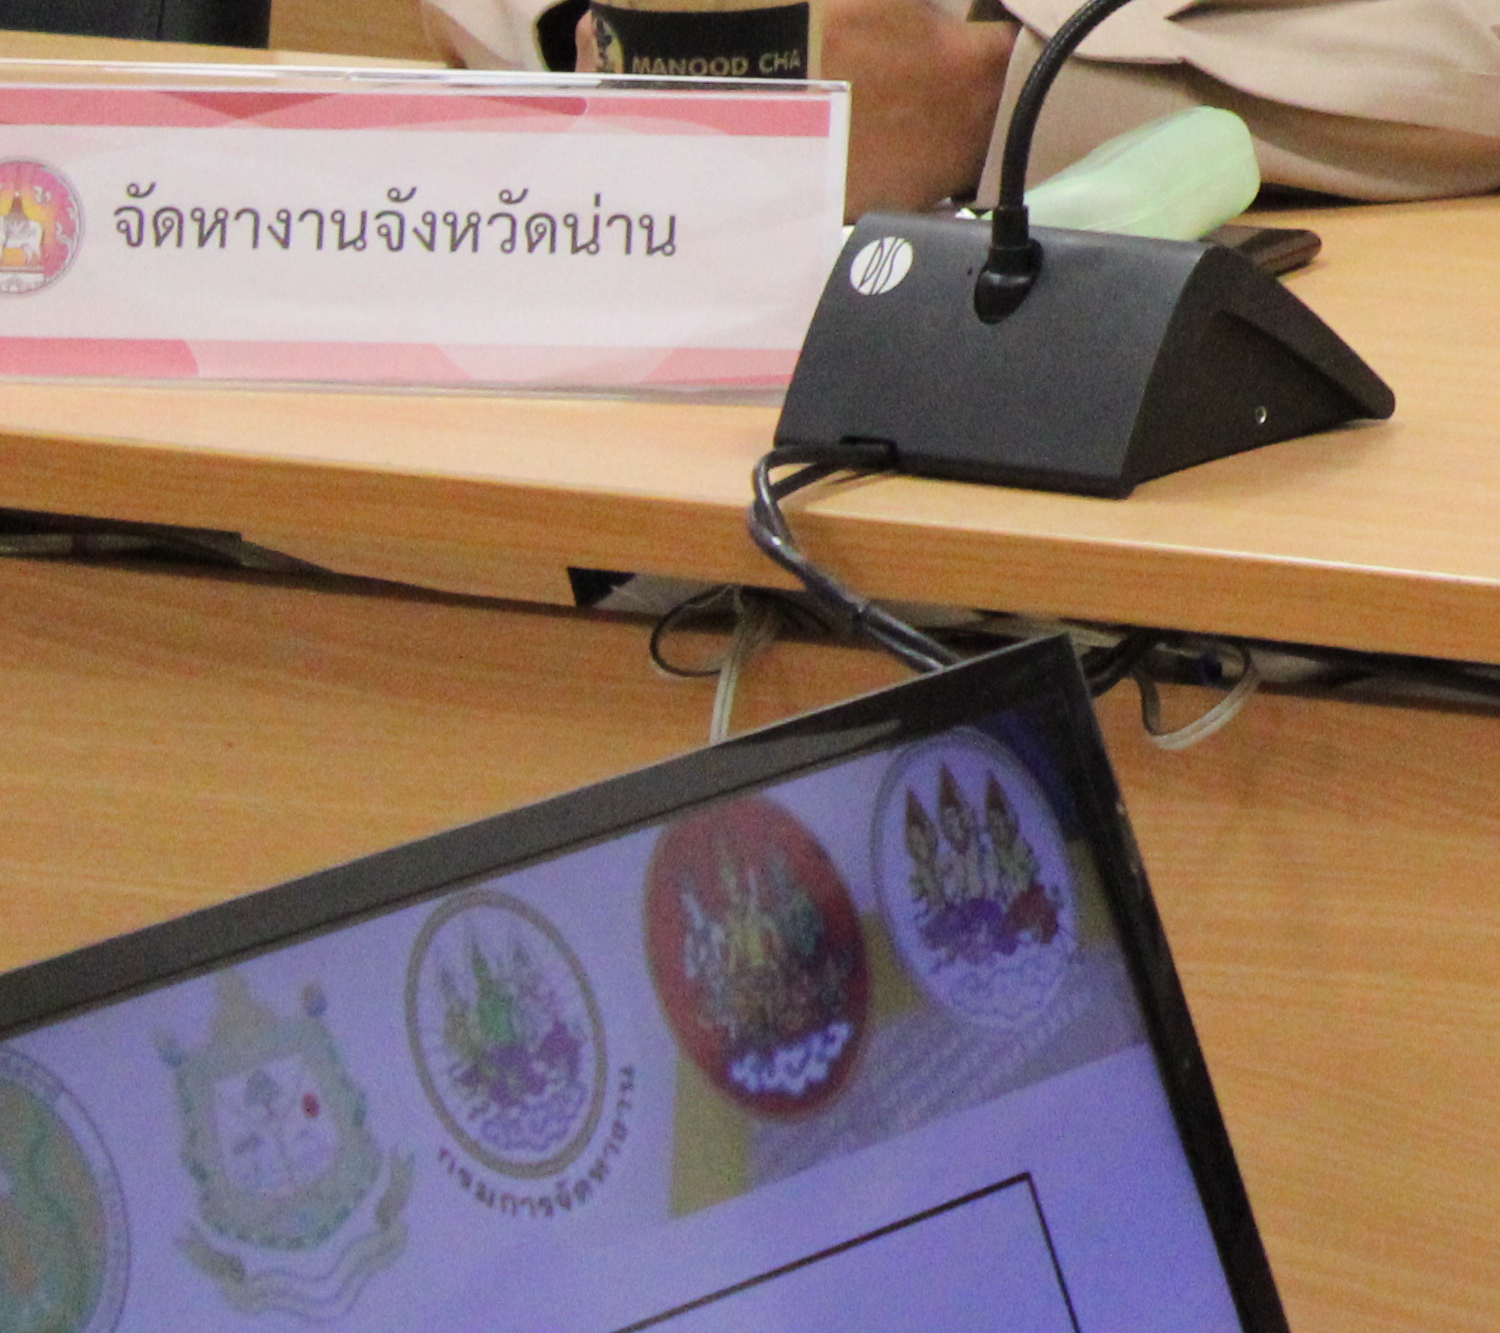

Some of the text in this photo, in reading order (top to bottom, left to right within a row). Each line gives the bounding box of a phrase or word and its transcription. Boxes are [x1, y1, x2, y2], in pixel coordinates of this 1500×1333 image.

[632, 55, 749, 76] MANOOD
[113, 182, 678, 258] จัดหางานจังหวัดน่าน
